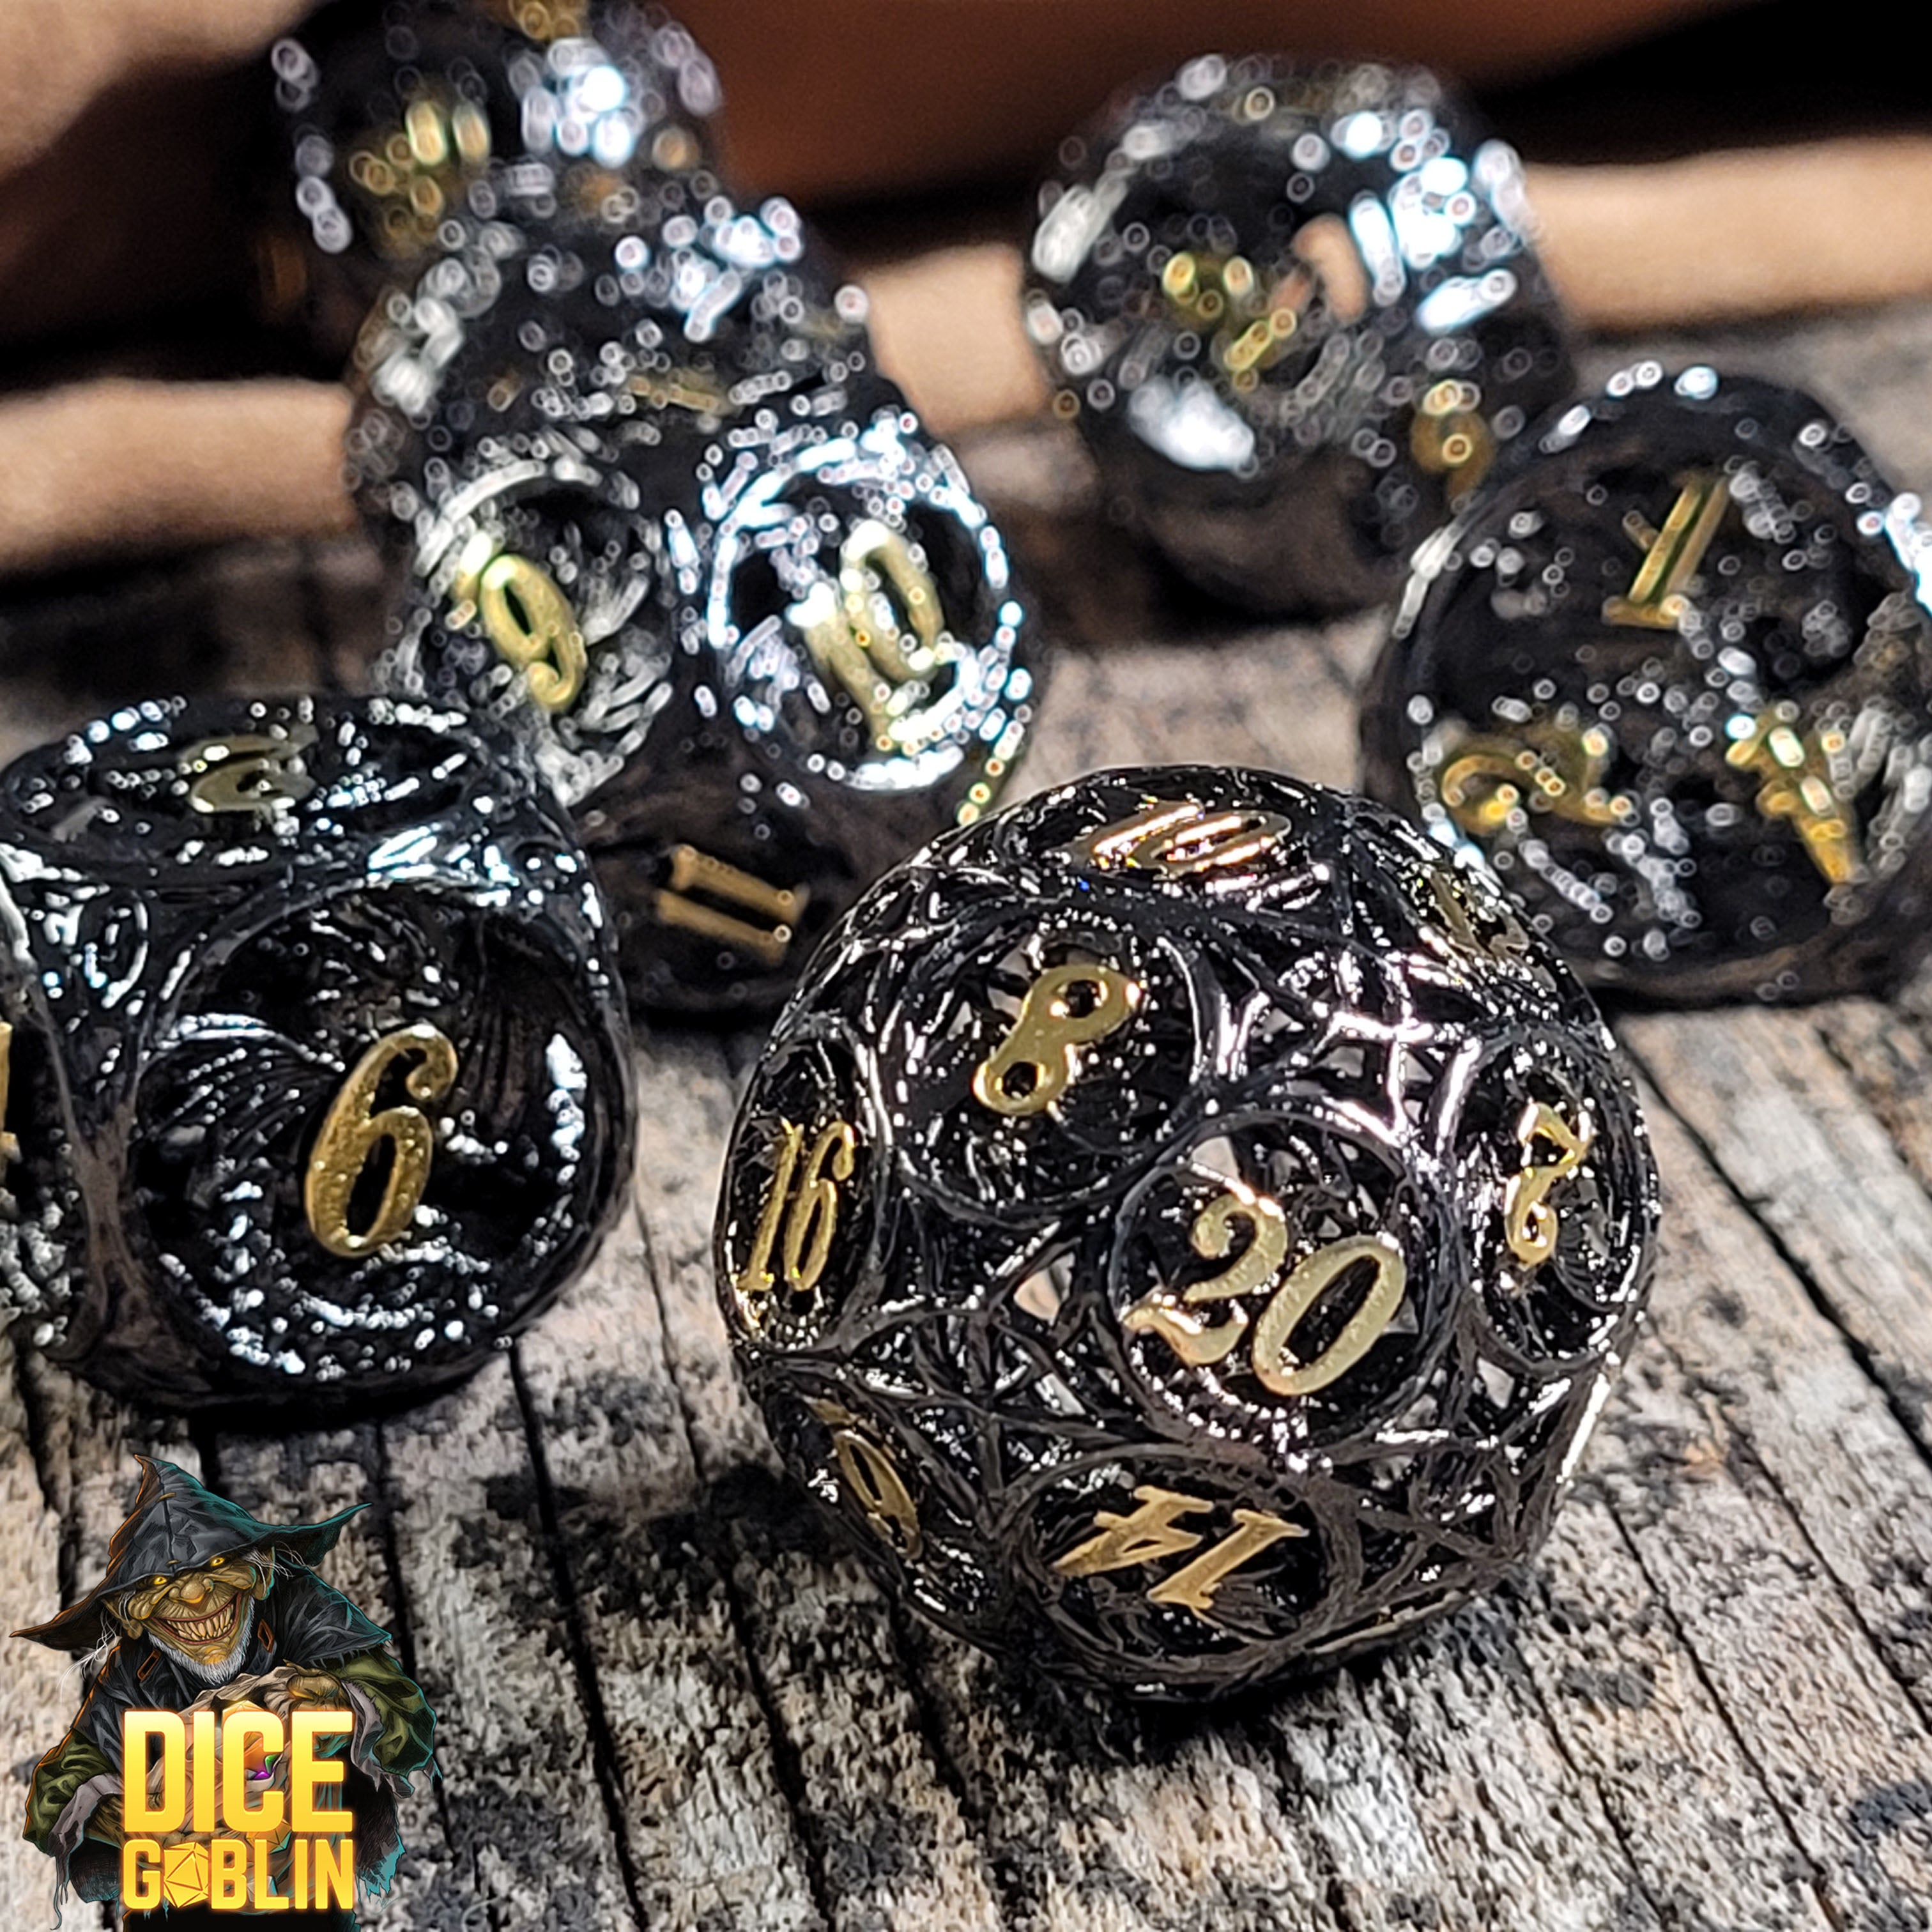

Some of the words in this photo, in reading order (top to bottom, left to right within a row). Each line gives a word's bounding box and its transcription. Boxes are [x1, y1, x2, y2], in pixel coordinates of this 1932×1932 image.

[972, 962, 1144, 1116] 8
[304, 1022, 457, 1257] 6
[735, 1114, 856, 1292] 16
[1121, 1183, 1406, 1397] 20
[1054, 1484, 1310, 1610] 14
